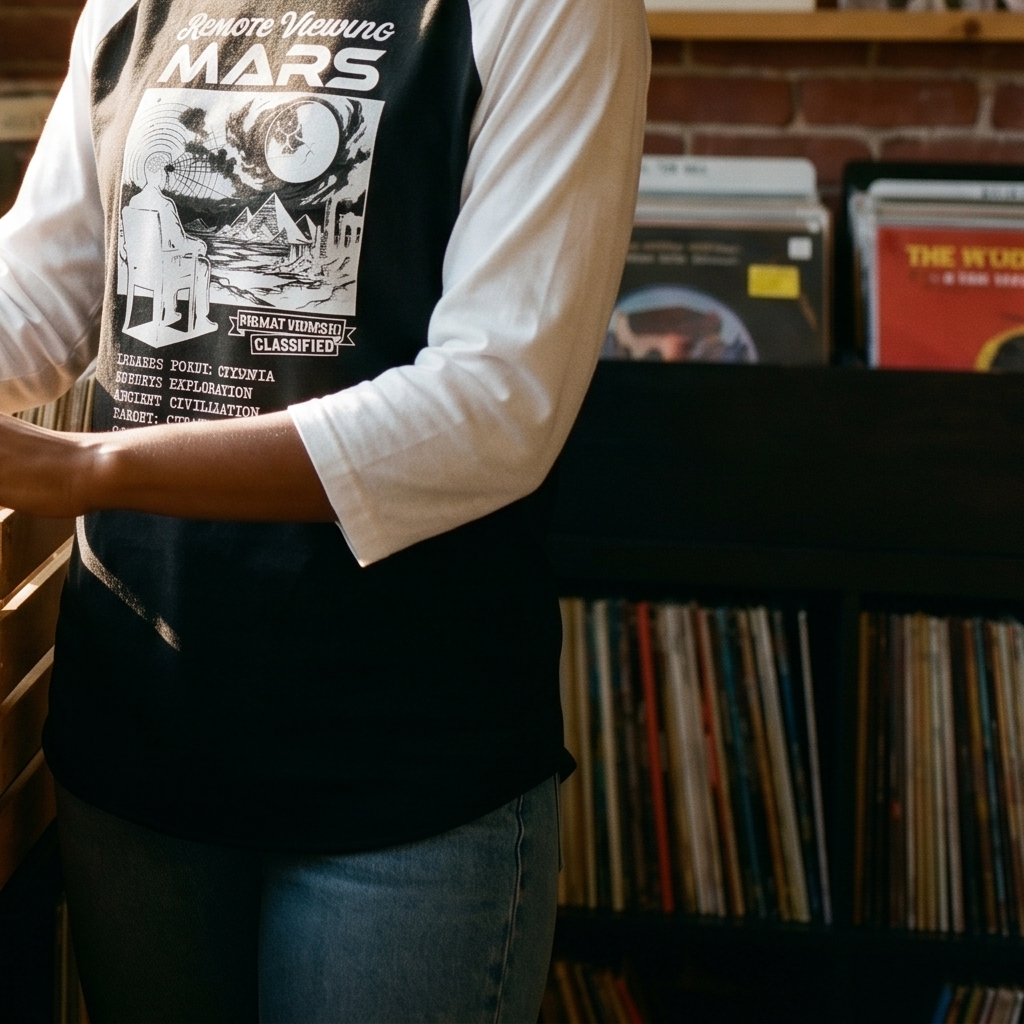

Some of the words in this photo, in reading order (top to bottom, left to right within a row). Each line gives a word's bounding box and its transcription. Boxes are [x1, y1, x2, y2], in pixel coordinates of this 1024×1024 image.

[157, 42, 387, 91] MARS
[906, 243, 956, 268] THE
[254, 337, 335, 353] CLASSIFIED
